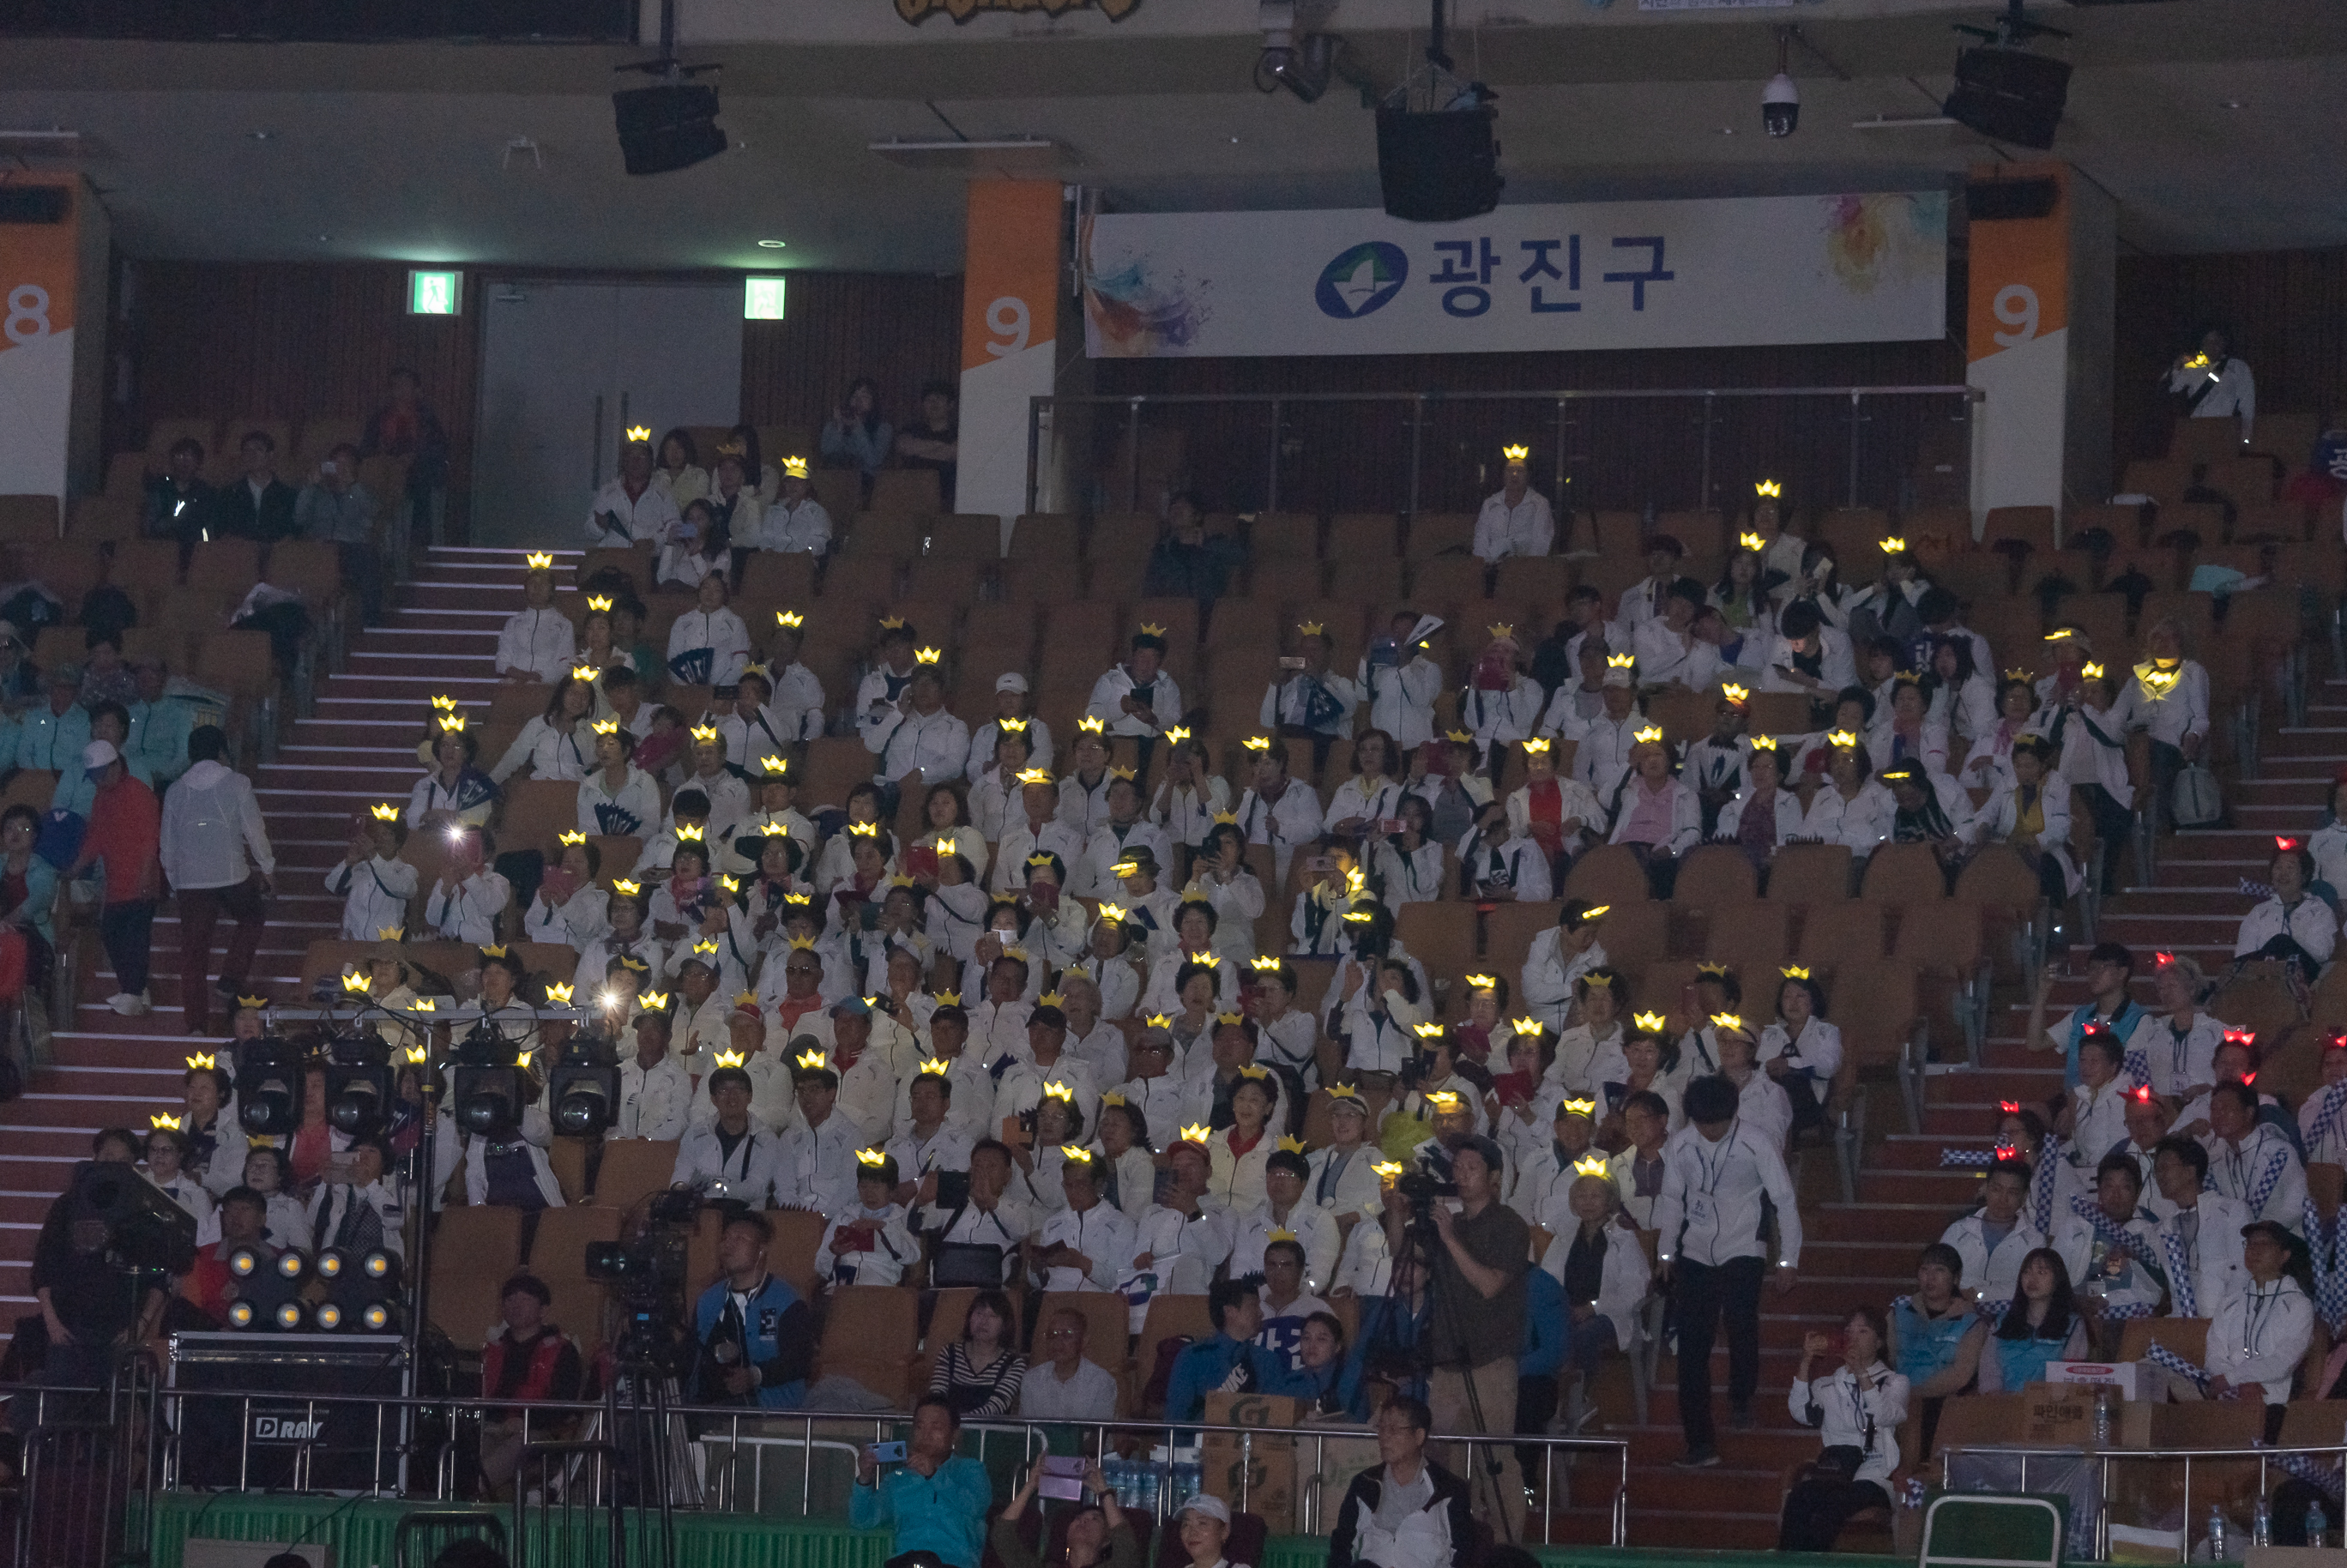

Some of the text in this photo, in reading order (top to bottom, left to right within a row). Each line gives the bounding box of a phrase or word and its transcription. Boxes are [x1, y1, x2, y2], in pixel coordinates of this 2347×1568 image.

[1429, 234, 1674, 318] 광진구
[3, 283, 51, 347] 8
[985, 296, 1031, 360] 9
[1992, 283, 2040, 350] 9
